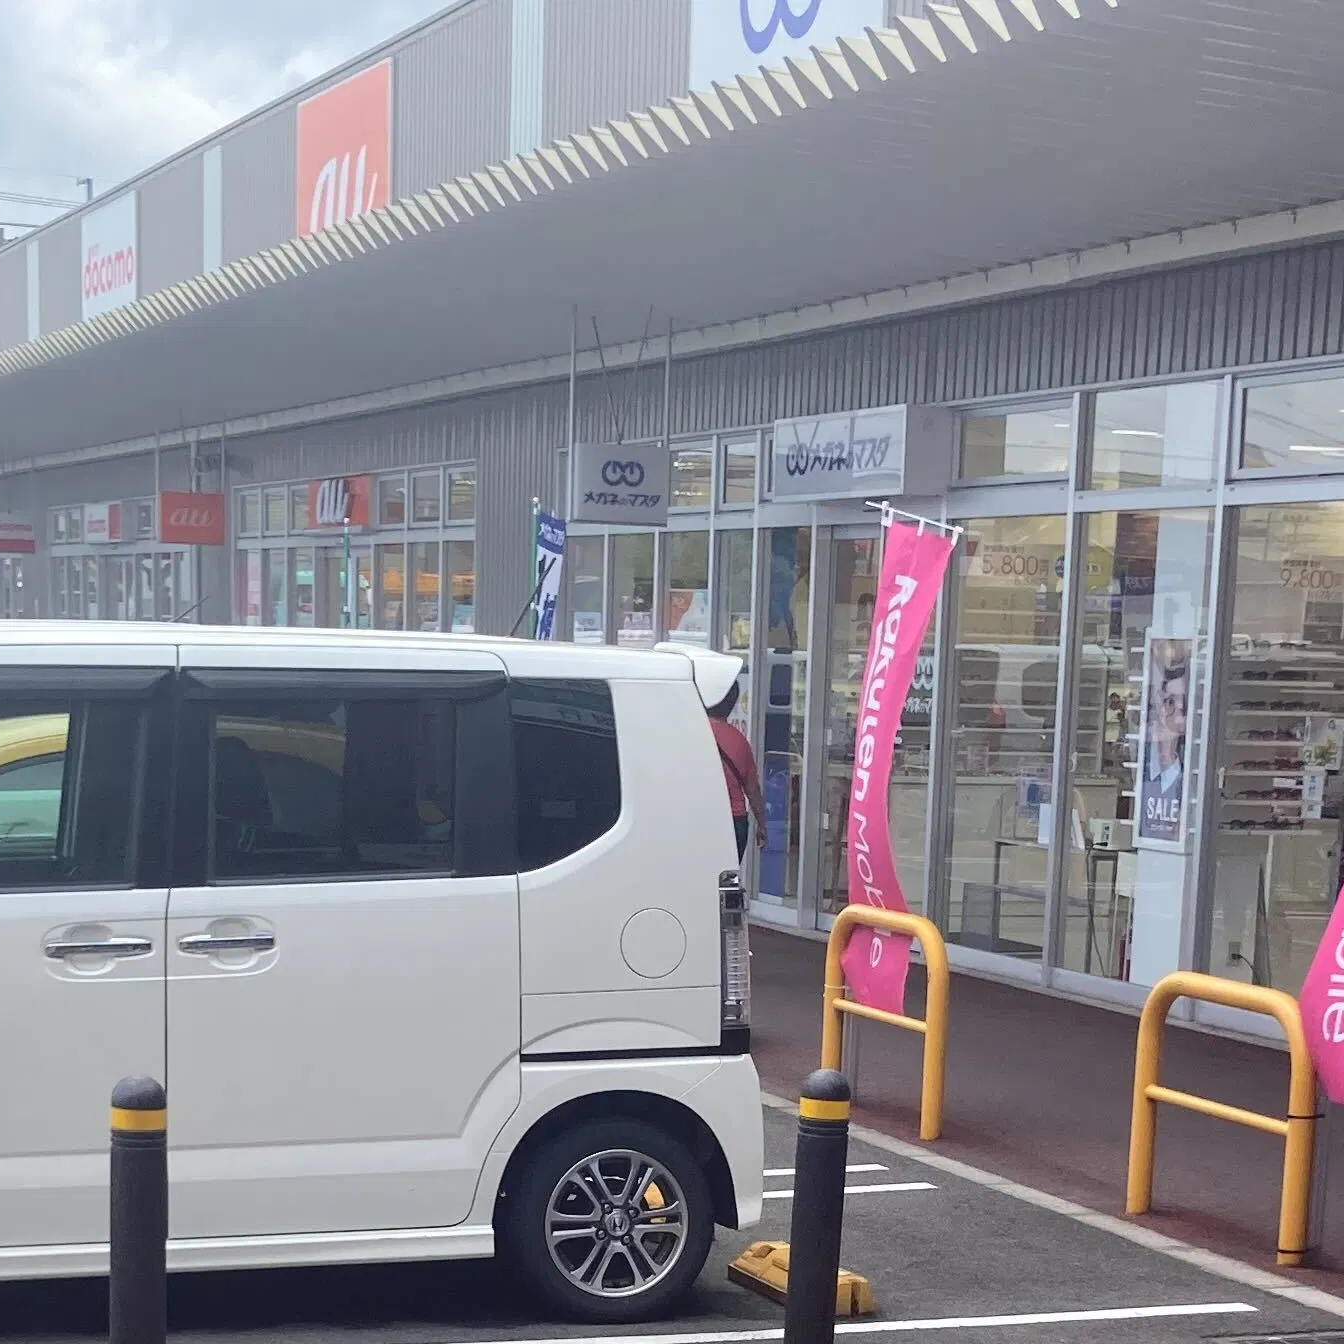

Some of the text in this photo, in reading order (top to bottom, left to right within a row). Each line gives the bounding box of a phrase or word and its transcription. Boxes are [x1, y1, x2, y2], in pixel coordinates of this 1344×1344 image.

[169, 507, 213, 527] au
[851, 574, 918, 968] Rakuten Moble
[1146, 796, 1179, 822] SALE
